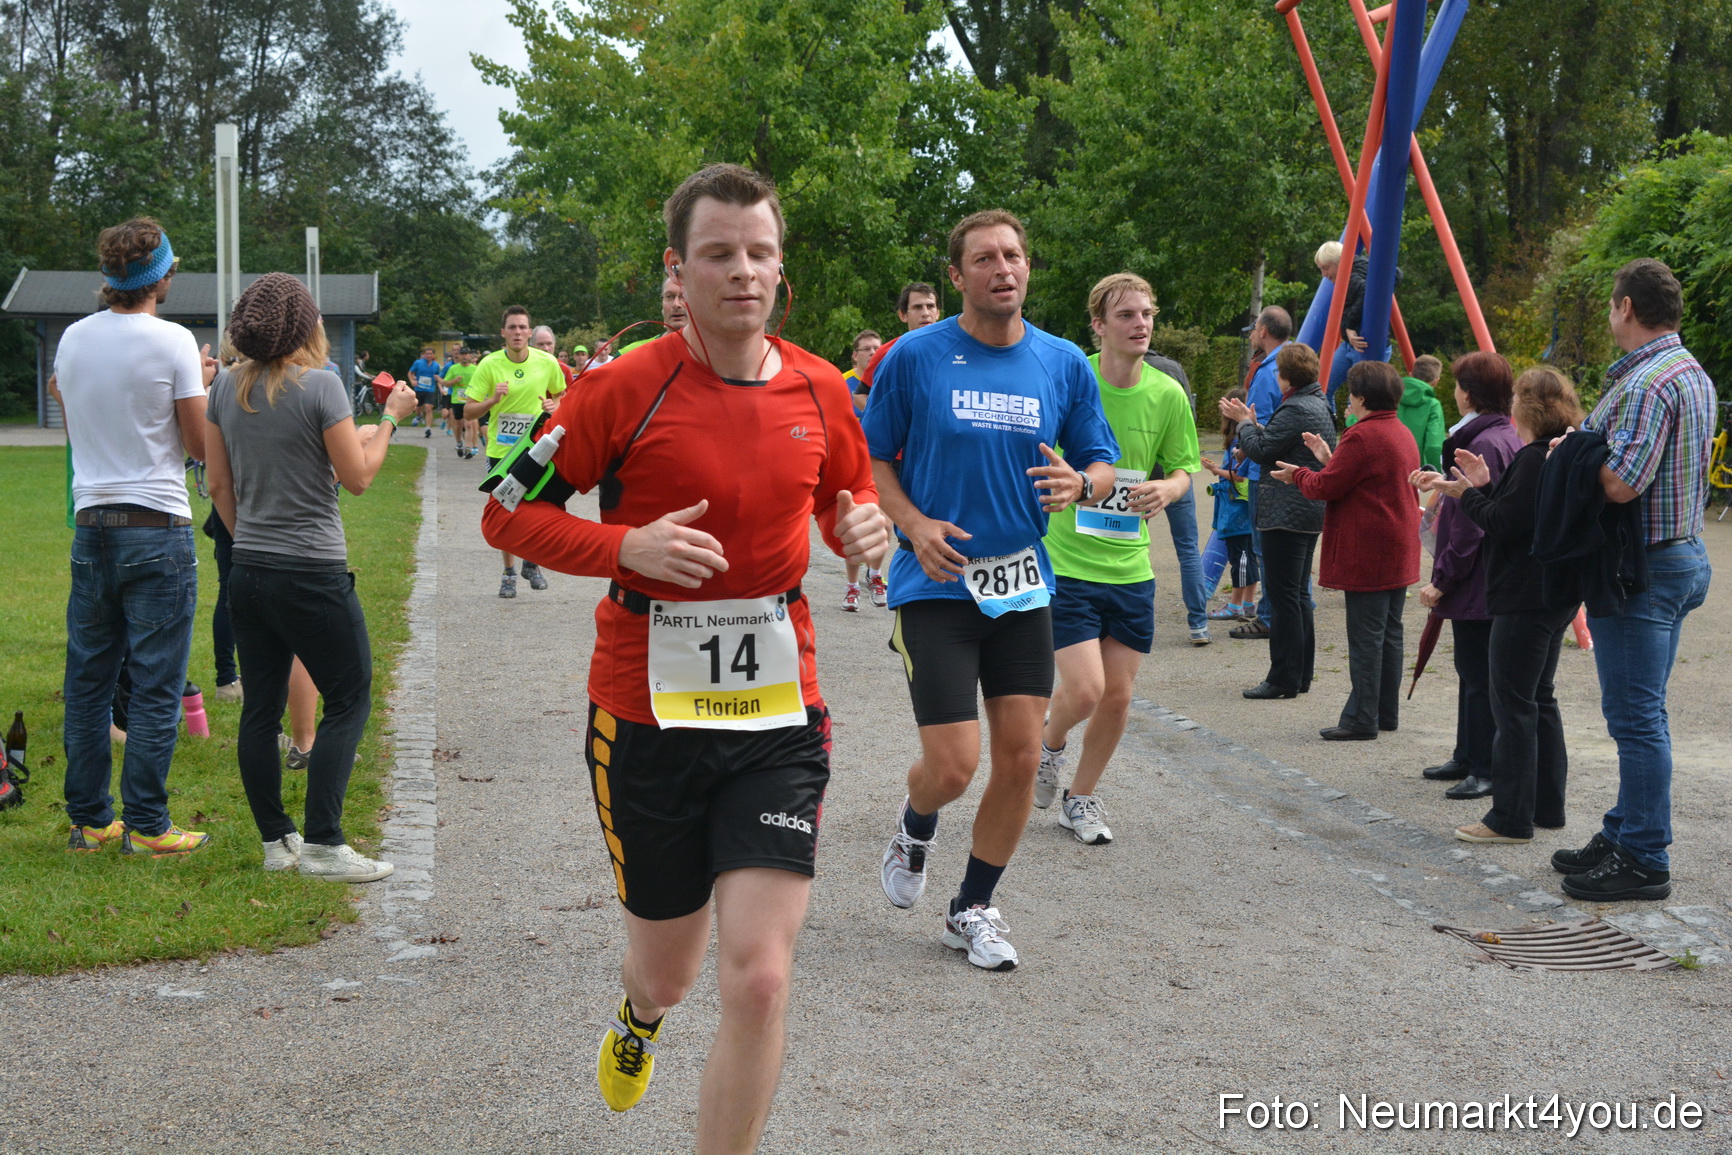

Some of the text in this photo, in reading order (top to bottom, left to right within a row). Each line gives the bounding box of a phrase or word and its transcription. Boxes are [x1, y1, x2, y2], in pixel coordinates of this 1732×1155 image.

[952, 389, 1040, 417] HUBER
[972, 411, 1037, 425] TECHNOLOGY
[971, 421, 1037, 435] WASTE WATER Solutions
[89, 513, 128, 526] PMA
[1103, 516, 1121, 529] Tim
[972, 555, 1040, 597] 2876
[653, 611, 775, 628] PARTL Neumarkt
[699, 633, 760, 684] 14
[694, 697, 761, 716] Florian
[759, 811, 812, 834] adidas
